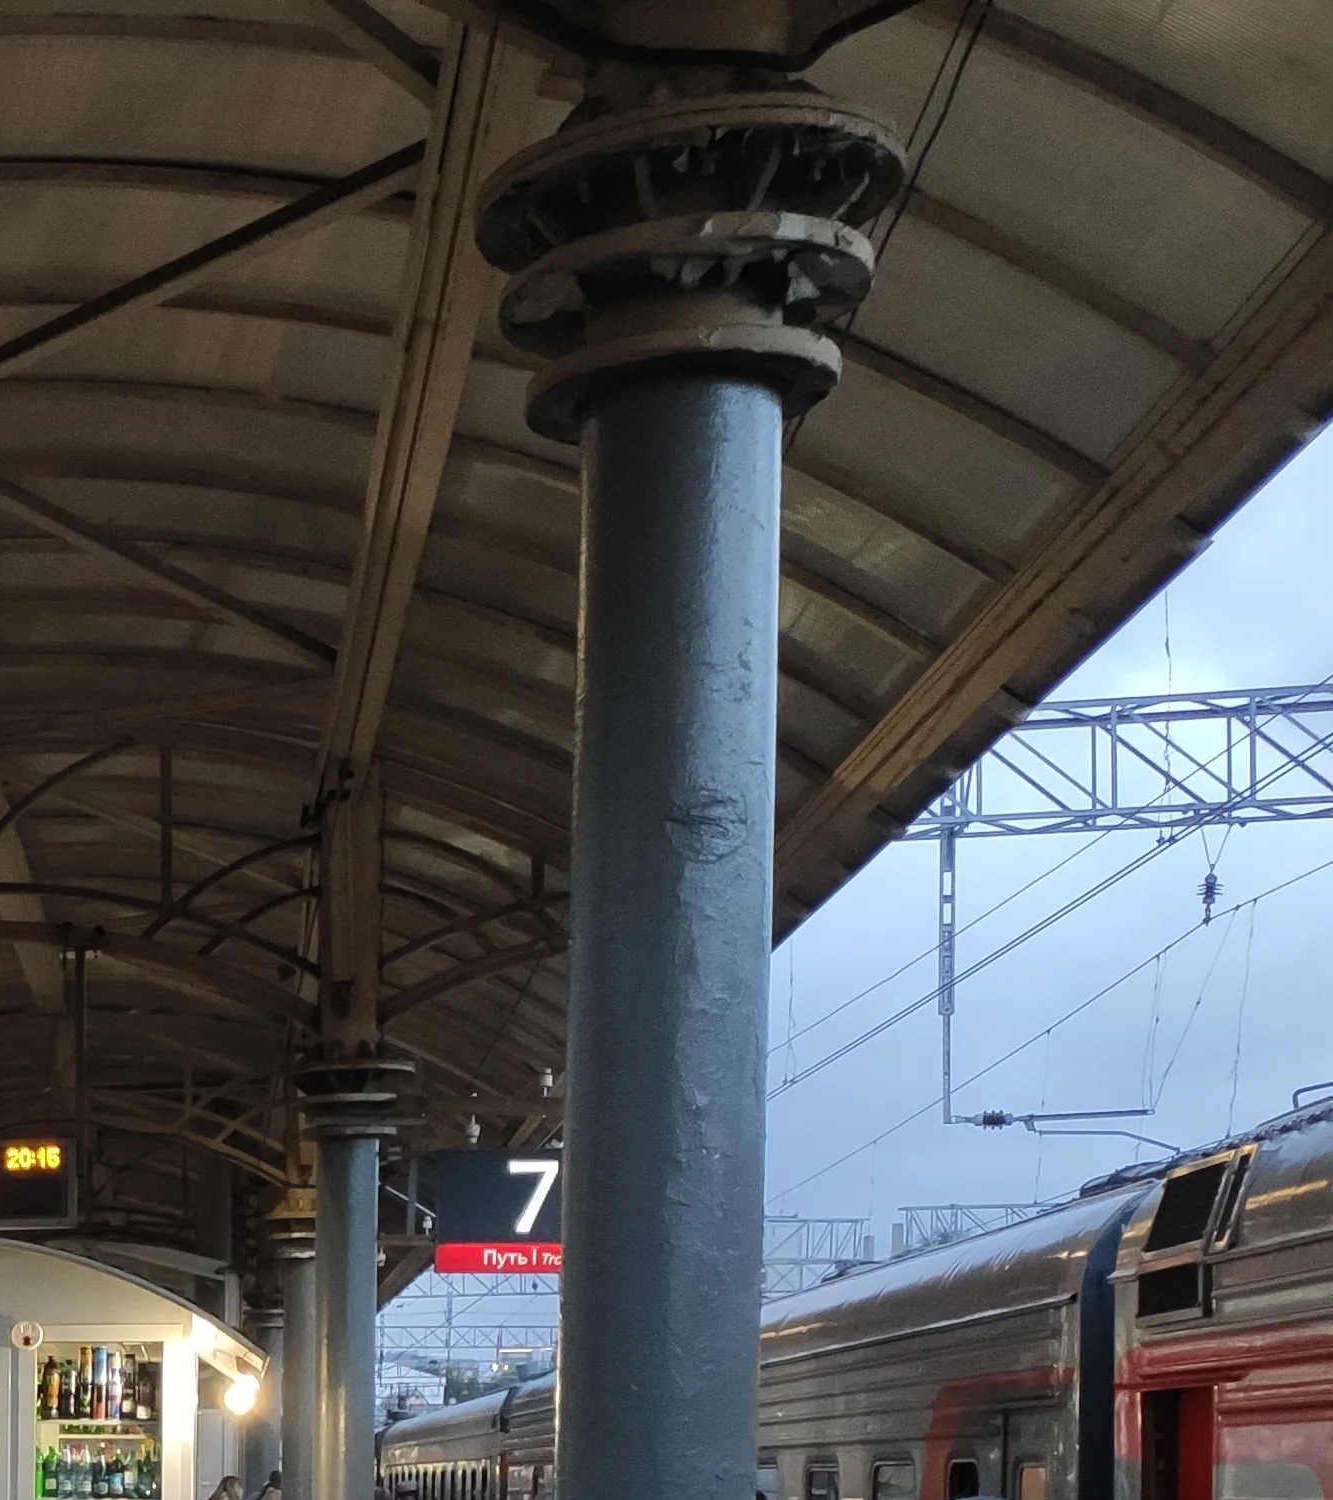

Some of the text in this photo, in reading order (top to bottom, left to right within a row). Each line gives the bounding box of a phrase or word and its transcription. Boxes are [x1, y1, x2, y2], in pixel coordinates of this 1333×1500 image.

[6, 1146, 61, 1170] 20:15
[507, 1159, 559, 1235] 7
[483, 1249, 528, 1269] Путь
